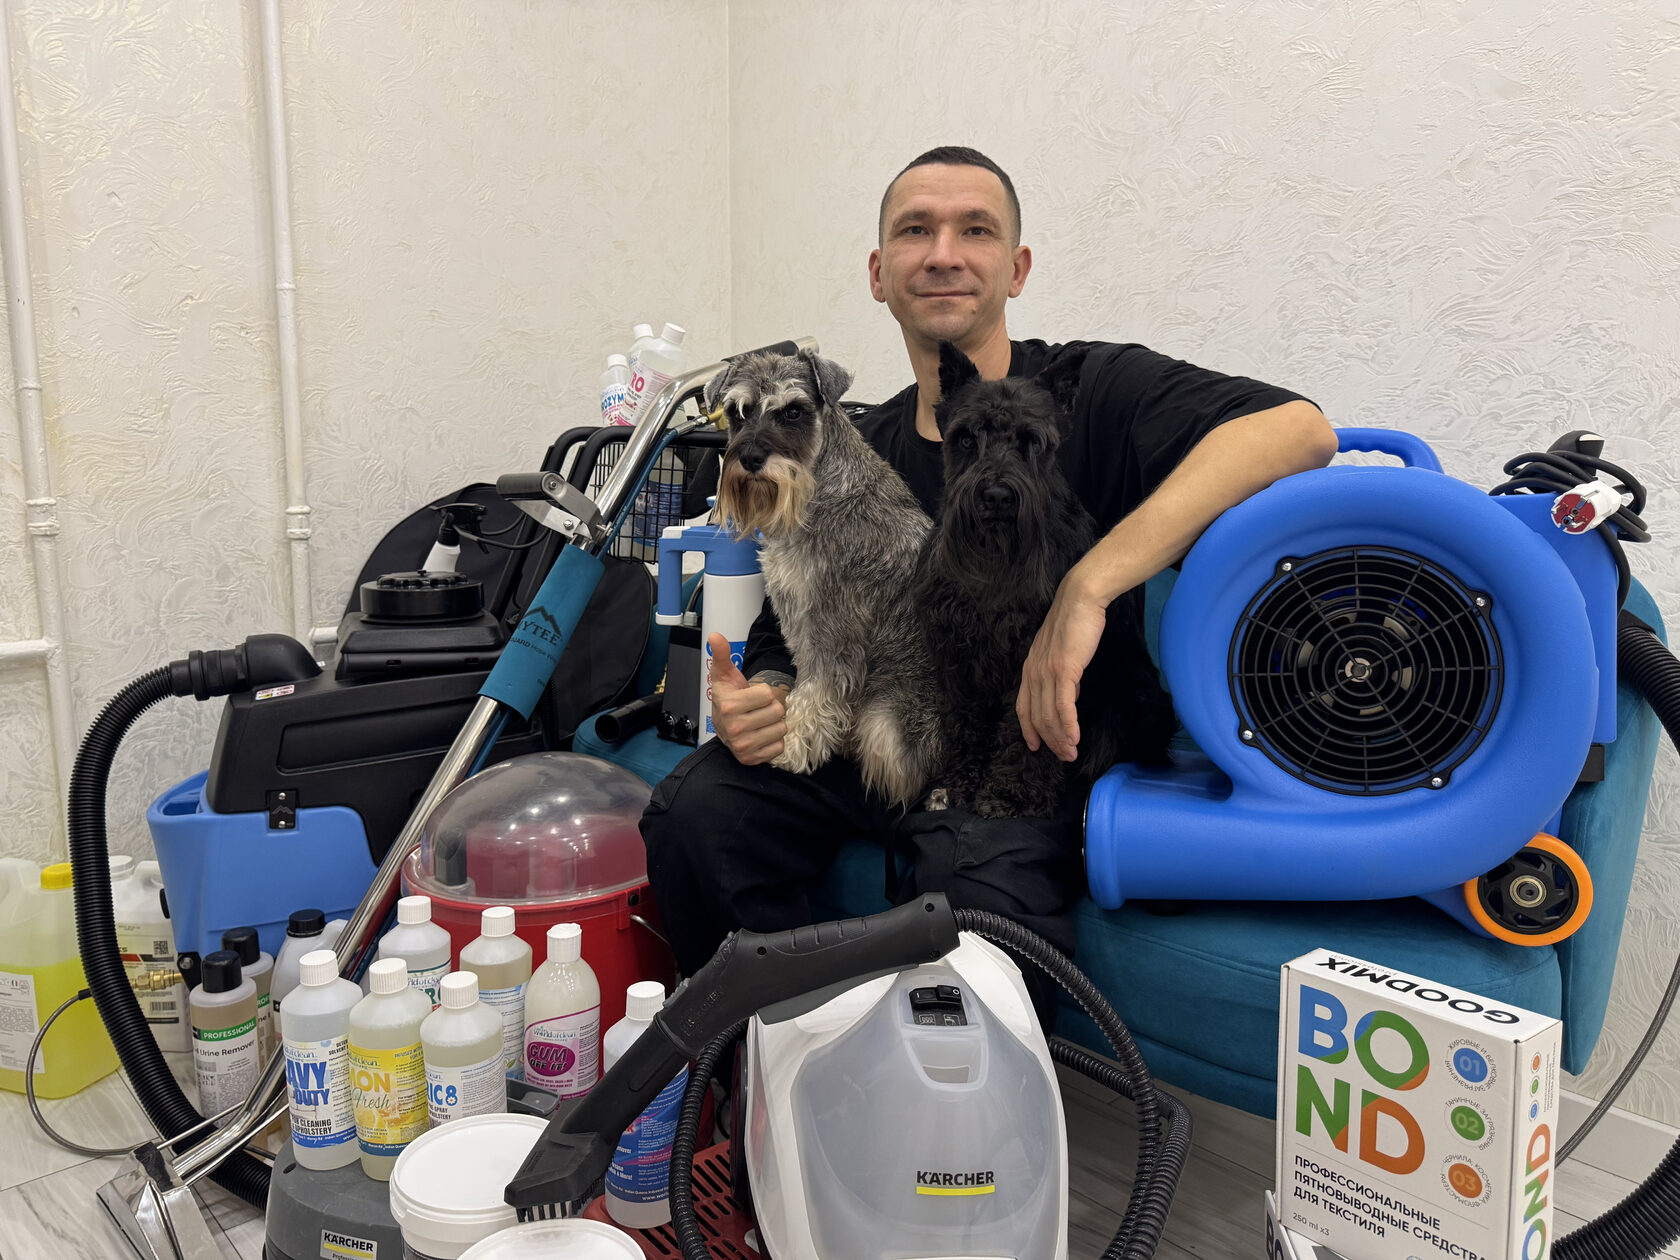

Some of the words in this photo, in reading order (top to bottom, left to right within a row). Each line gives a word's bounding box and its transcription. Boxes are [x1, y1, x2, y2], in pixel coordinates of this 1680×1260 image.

[1315, 957, 1520, 1024] GOODMIX
[204, 1020, 254, 1039] PROFESSIONAL
[221, 1040, 255, 1056] Remover
[530, 1044, 568, 1062] GUM
[287, 1058, 327, 1090] AVY
[1460, 1056, 1480, 1076] 01
[294, 1088, 330, 1106] DUTY
[300, 1118, 332, 1128] CLEANING
[1455, 1112, 1479, 1134] 02
[916, 1170, 994, 1186] KÄRCHER
[1452, 1170, 1476, 1190] 03
[1294, 1170, 1410, 1233] ПЯТНОВЫВОДНЫЕ
[1295, 1155, 1440, 1230] ПРОФЕССИОНАЛЬНЫЕ
[1522, 1123, 1551, 1260] OND
[1294, 1186, 1319, 1206] ДЛЯ
[1322, 1198, 1385, 1238] ТЕКСТИЛЯ
[1292, 1212, 1307, 1225] 250
[1309, 1221, 1318, 1230] ml
[1320, 1227, 1330, 1236] x3
[324, 1232, 374, 1252] KÄRCHER
